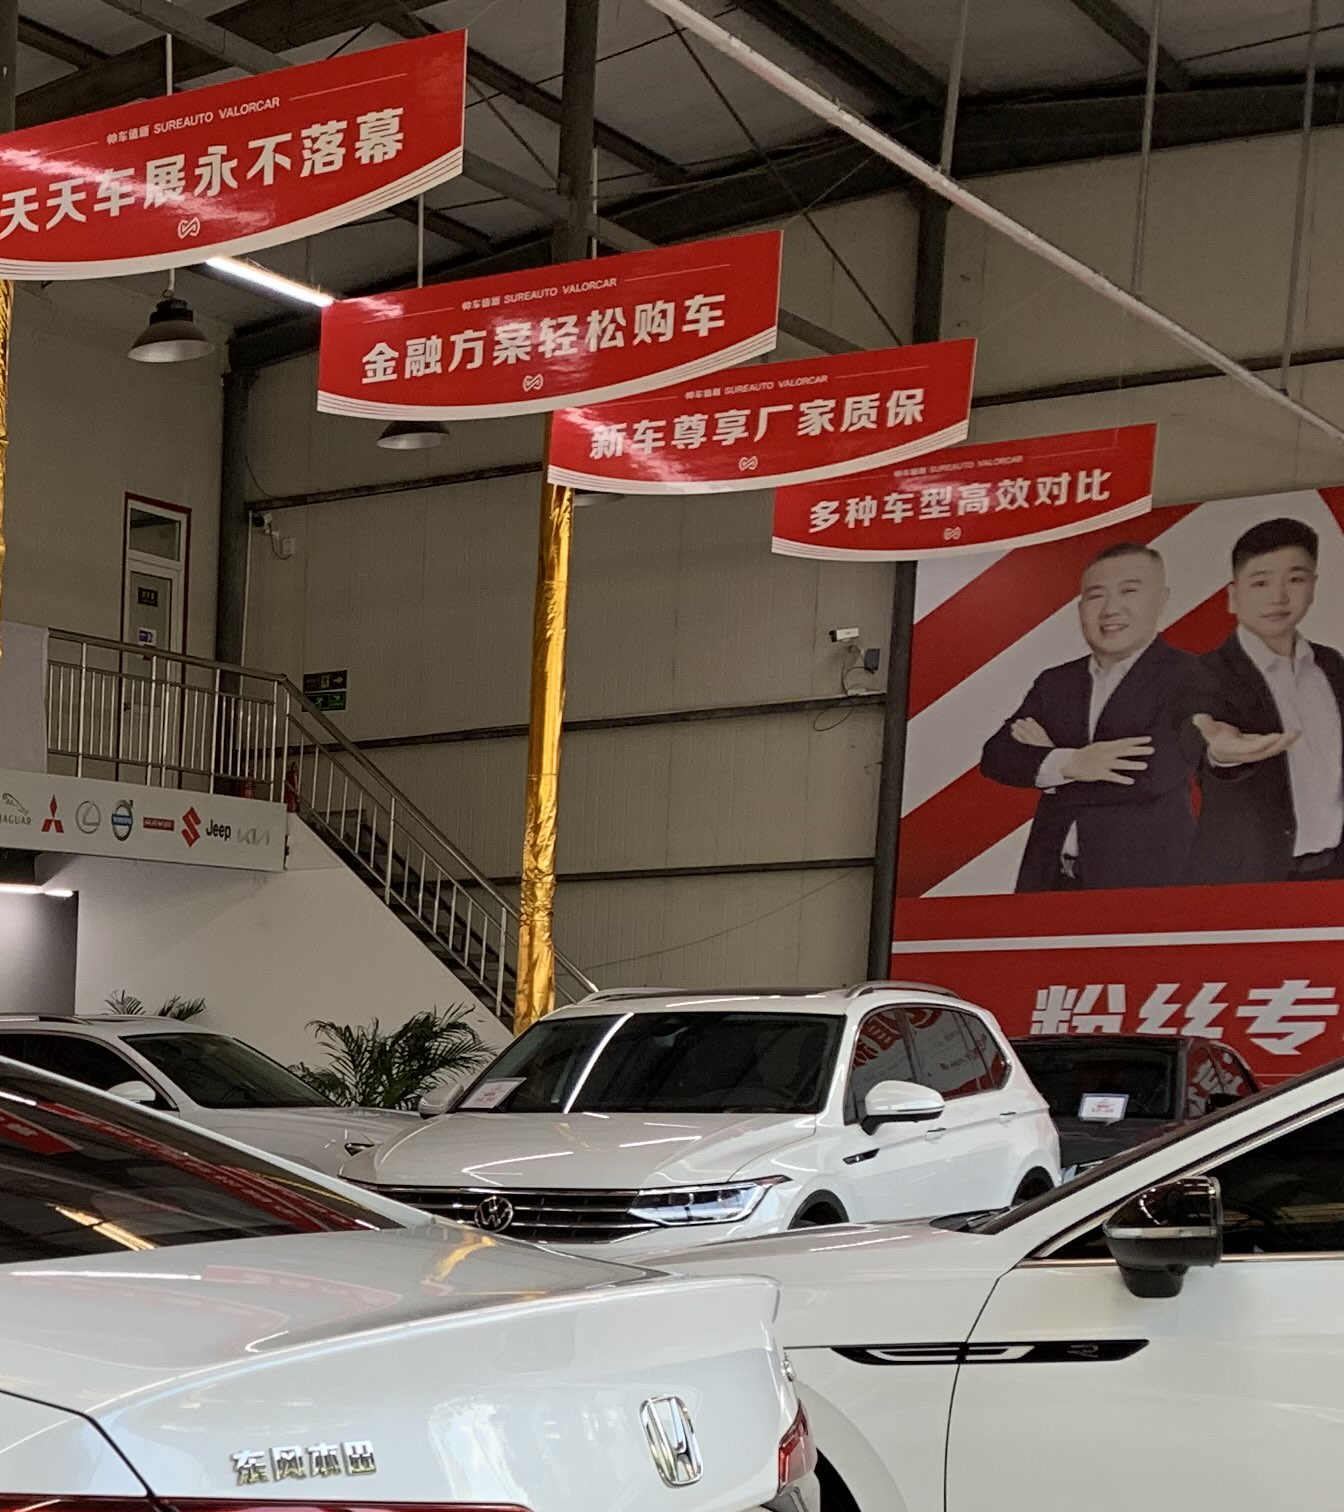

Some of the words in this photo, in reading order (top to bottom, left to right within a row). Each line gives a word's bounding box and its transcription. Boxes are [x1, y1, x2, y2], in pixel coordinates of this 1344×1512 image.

[153, 111, 214, 135] SUREAUTO
[218, 97, 280, 120] VALORCAR
[0, 107, 405, 241] 天天车展永不落幕
[503, 287, 558, 304] SUREAUTO
[562, 278, 617, 294] VALORCAR
[361, 294, 726, 385] 金融方案轻松购车
[589, 388, 926, 460] 新车尊享厂家质保
[809, 468, 1113, 533] 多种车型高效对比
[0, 814, 31, 826] JAGUAR
[205, 819, 232, 841] Jeep
[1030, 979, 1340, 1055] 粉丝专
[230, 1440, 377, 1487] 东风本田
